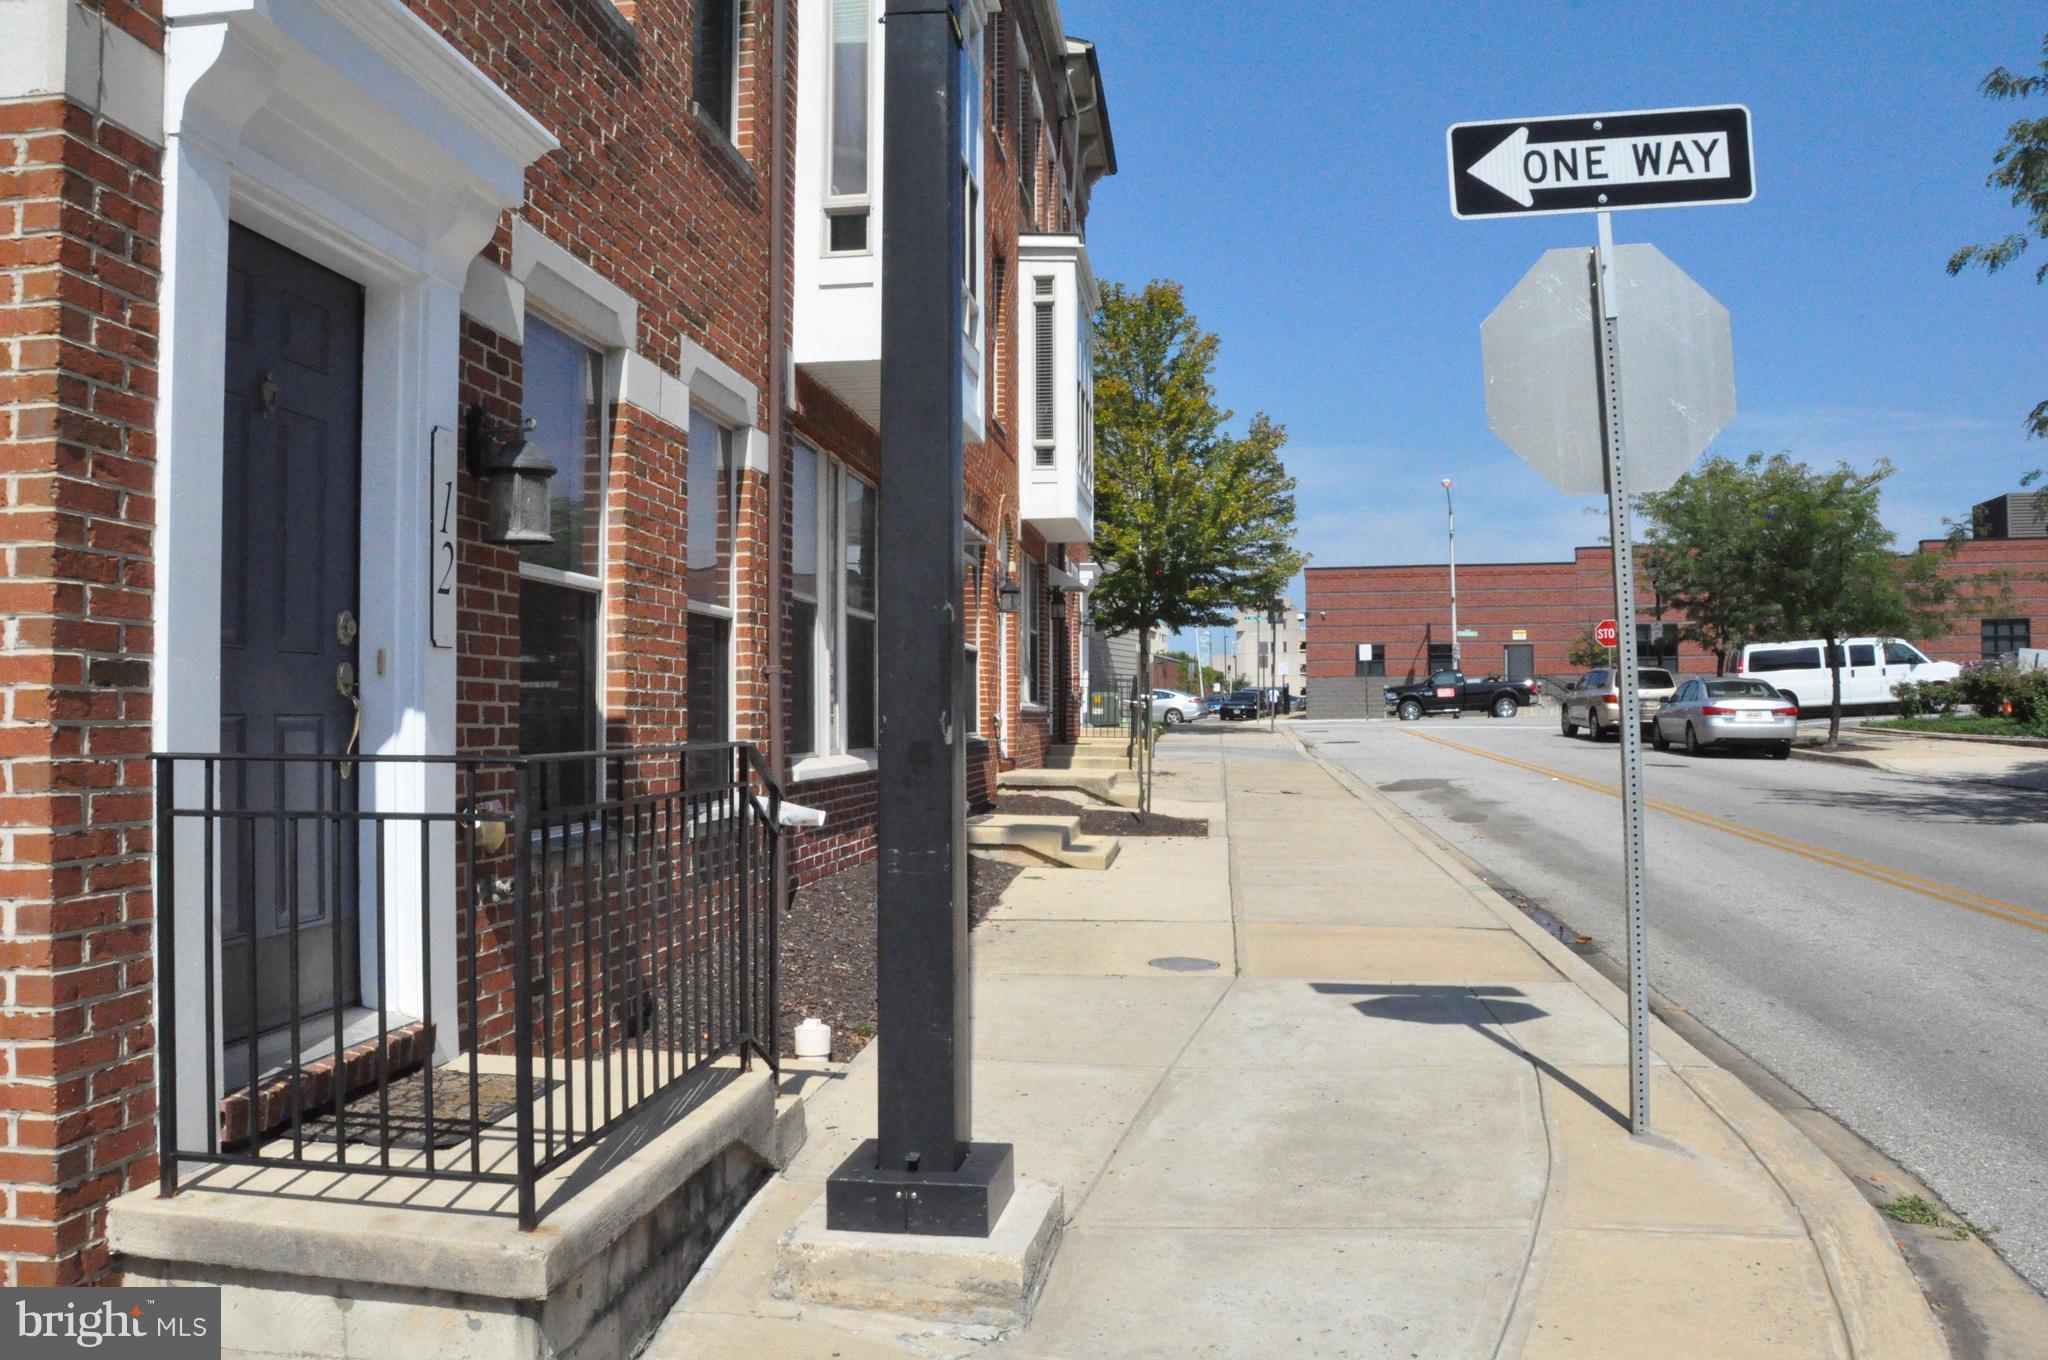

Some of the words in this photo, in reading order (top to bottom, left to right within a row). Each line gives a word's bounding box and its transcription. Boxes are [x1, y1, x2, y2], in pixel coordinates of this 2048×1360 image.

[1523, 145, 1609, 184] ONE
[1632, 137, 1720, 177] WAY
[437, 481, 454, 595] 12
[1597, 628, 1615, 639] STO
